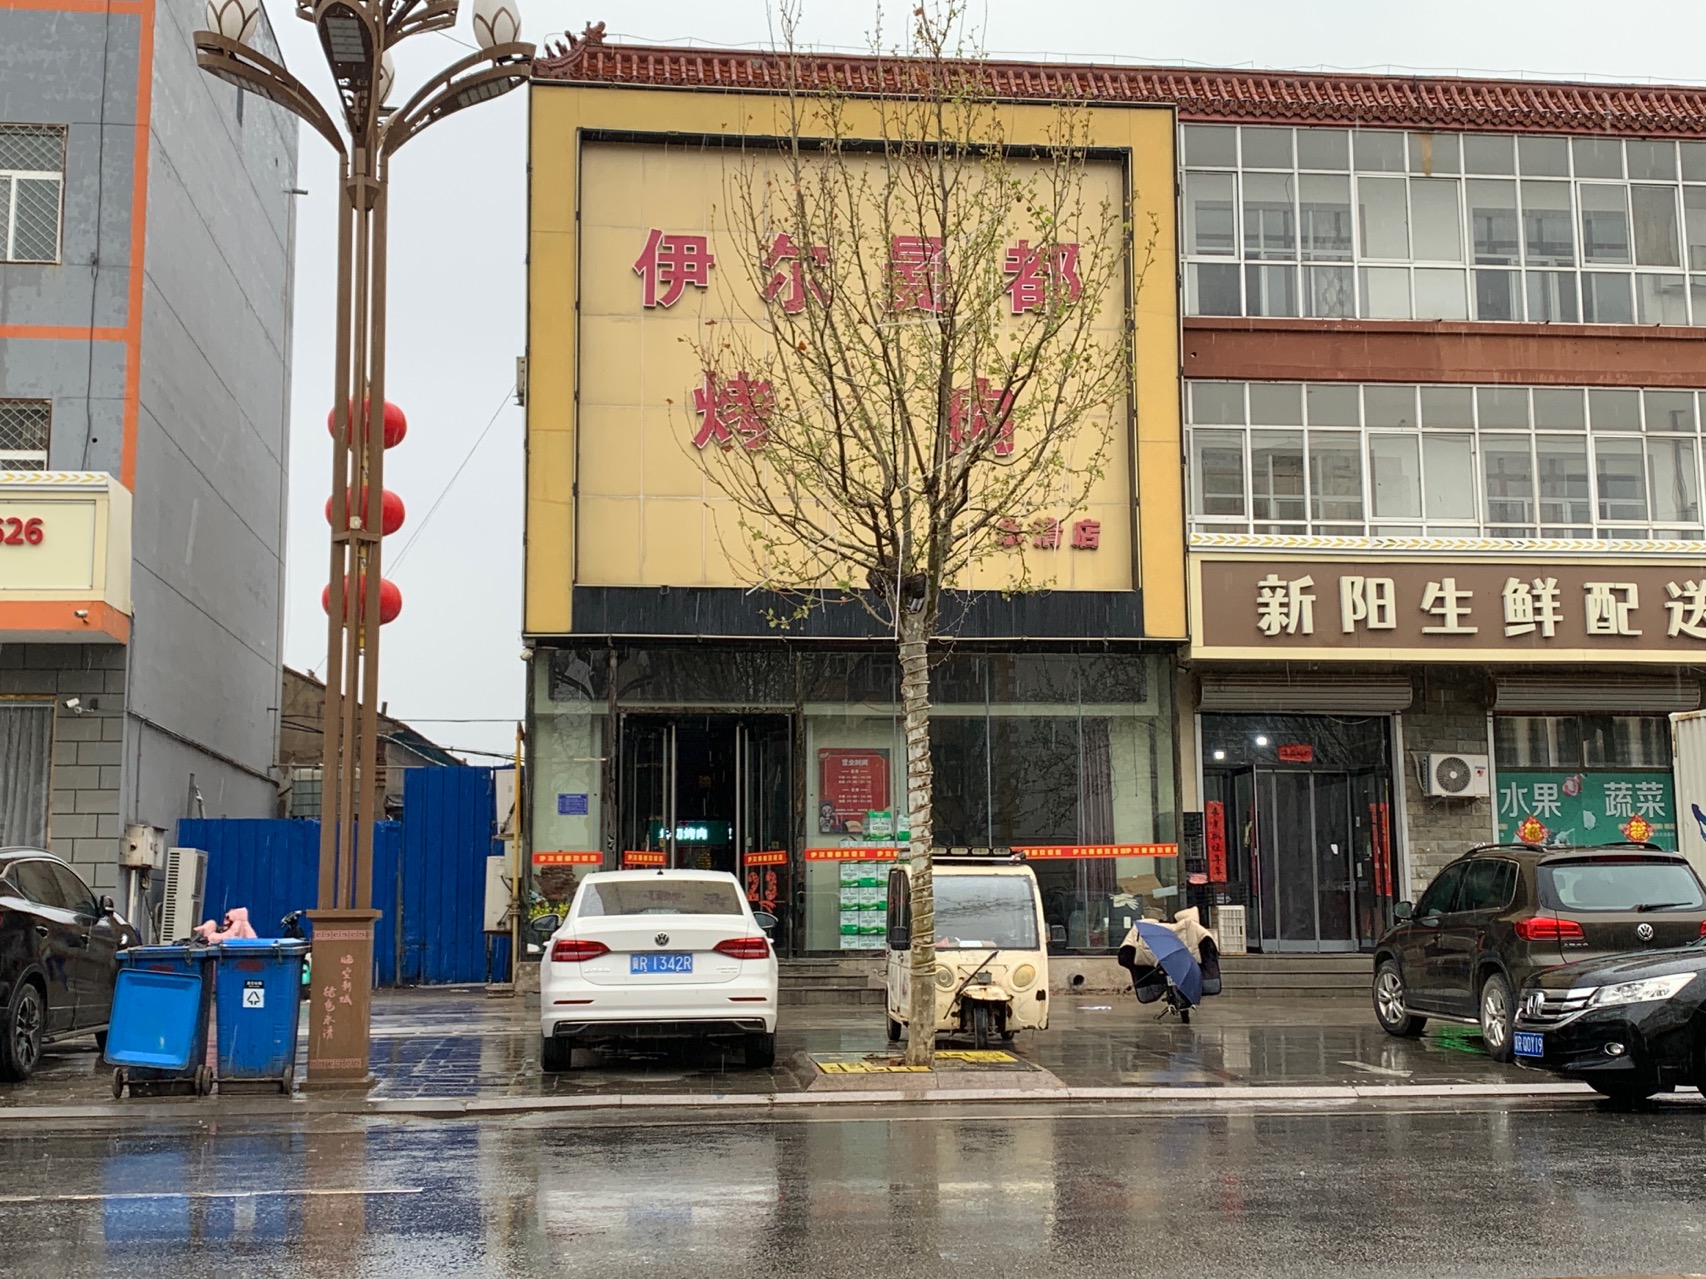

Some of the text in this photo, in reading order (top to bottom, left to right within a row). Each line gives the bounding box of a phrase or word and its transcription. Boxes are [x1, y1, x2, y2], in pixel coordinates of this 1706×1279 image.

[691, 370, 1015, 457] 烤肉
[0, 517, 44, 545] 26
[1256, 573, 1706, 639] 新阳生鲜配送
[1500, 781, 1666, 818] 水果 蔬菜
